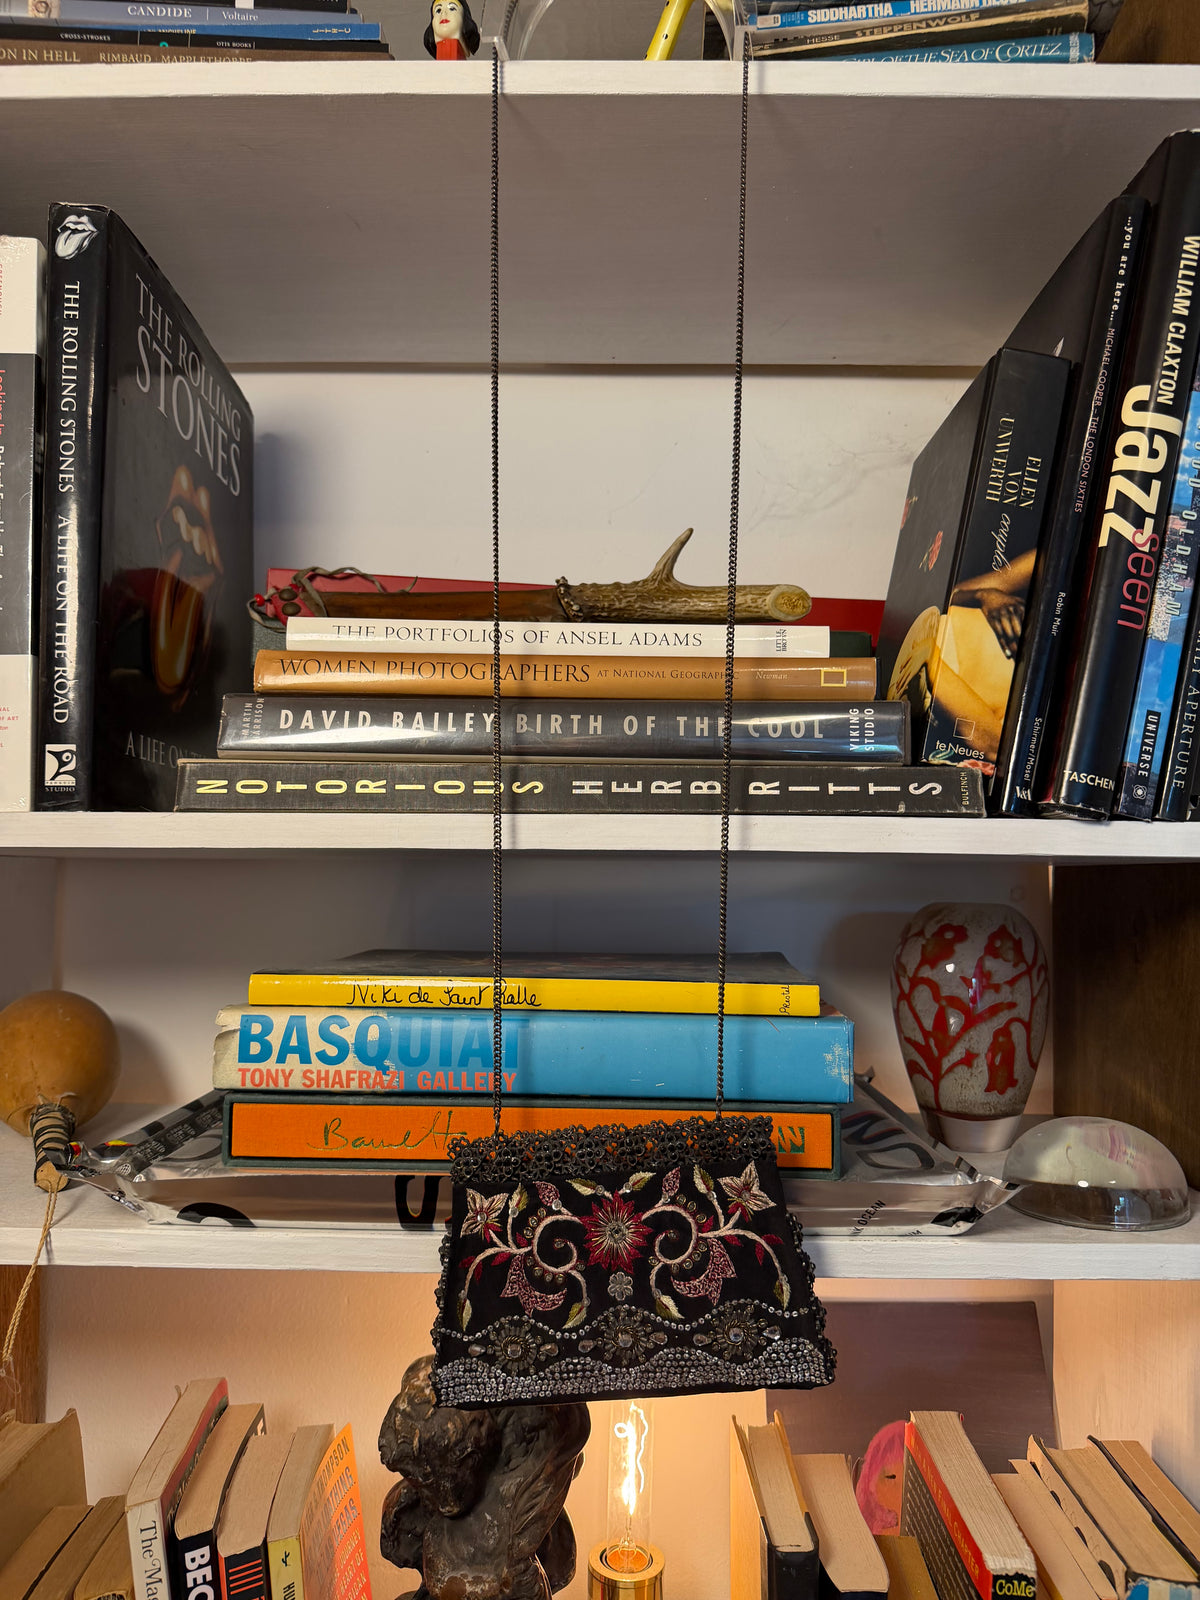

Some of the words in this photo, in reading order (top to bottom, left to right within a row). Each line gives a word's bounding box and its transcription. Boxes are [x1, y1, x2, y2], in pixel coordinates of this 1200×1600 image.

[127, 5, 192, 18] CANDIDE
[222, 11, 259, 21] Voltaire
[808, 3, 893, 24] SIDDHARTHA
[910, 0, 979, 14] HERMANN
[855, 13, 980, 37] STEPPENWOLF
[60, 33, 111, 41] CROSS-STROKES
[806, 34, 841, 44] HESSE
[903, 52, 938, 63] THE
[939, 49, 969, 63] SEA
[971, 47, 995, 61] OF
[995, 42, 1062, 62] CORTEZ
[23, 50, 38, 61] IN
[43, 50, 80, 62] HELL
[100, 52, 152, 63] RIMBAUD
[1118, 255, 1128, 276] are
[1171, 235, 1200, 317] WILLIAM
[63, 281, 81, 320] THE
[136, 273, 173, 354] THE
[178, 334, 241, 442] ROLLING
[1100, 328, 1116, 369] MICHAEL
[1156, 321, 1187, 406] CLAXTON
[60, 326, 79, 413] ROLLING
[1092, 369, 1108, 407] COOPER
[136, 325, 241, 497] STONES
[1088, 416, 1099, 434] THE
[58, 418, 76, 493] STONES
[985, 416, 1015, 503] UNWERTH
[1080, 434, 1095, 479] LONDON
[1098, 384, 1184, 553] Jazz
[1002, 471, 1022, 507] VON
[1019, 455, 1042, 511] ELLEN
[1074, 479, 1087, 513] SIXTIES
[57, 514, 72, 529] A
[56, 534, 75, 574] LIFE
[1165, 509, 1198, 616] OLDHAM
[55, 579, 74, 611] ON
[1116, 528, 1160, 631] seen
[1055, 591, 1067, 615] Robin
[54, 621, 73, 659] THE
[332, 624, 376, 638] THE
[384, 625, 514, 644] PORTFOLIOS
[523, 629, 549, 644] OF
[556, 631, 623, 646] ANSEL
[629, 632, 703, 647] ADAMS
[1051, 617, 1061, 637] Muir
[280, 658, 376, 677] WOMEN
[385, 660, 590, 683] PHOTOGRAPHERS
[596, 669, 610, 678] AT
[613, 668, 666, 679] NATIONAL
[755, 671, 788, 680] Newman
[53, 666, 74, 724] ROAD
[241, 702, 253, 737] MARTIN
[250, 697, 265, 737] ARRISON
[279, 709, 373, 730] DAVID
[391, 711, 496, 733] BAILEY
[516, 713, 602, 735] BIRTH
[623, 715, 656, 736] OF
[676, 716, 732, 737] THE
[748, 717, 824, 739] COOL
[849, 707, 860, 751] VIKING
[864, 707, 875, 752] STUDIO
[124, 730, 136, 758] A
[140, 734, 166, 766] LIFE
[1023, 717, 1043, 782] Schirmer/Mosel
[1138, 714, 1159, 778] UNIVERSE
[1172, 684, 1200, 790] APERTURE
[572, 779, 722, 796] HERB
[747, 780, 943, 796] RITTS
[960, 771, 970, 806] BULFINCH
[1063, 769, 1116, 792] TASCHEN
[347, 979, 402, 1006] Niki
[408, 985, 432, 1003] de
[439, 979, 490, 1006] Saint
[779, 984, 791, 1016] Prestel
[237, 1014, 530, 1073] BASQUIAT
[238, 1067, 294, 1088] TONY
[301, 1069, 405, 1090] SHAFRAZI
[857, 1200, 886, 1226] OCEAN
[140, 1520, 158, 1560] The
[953, 1521, 980, 1580] CHAPTER
